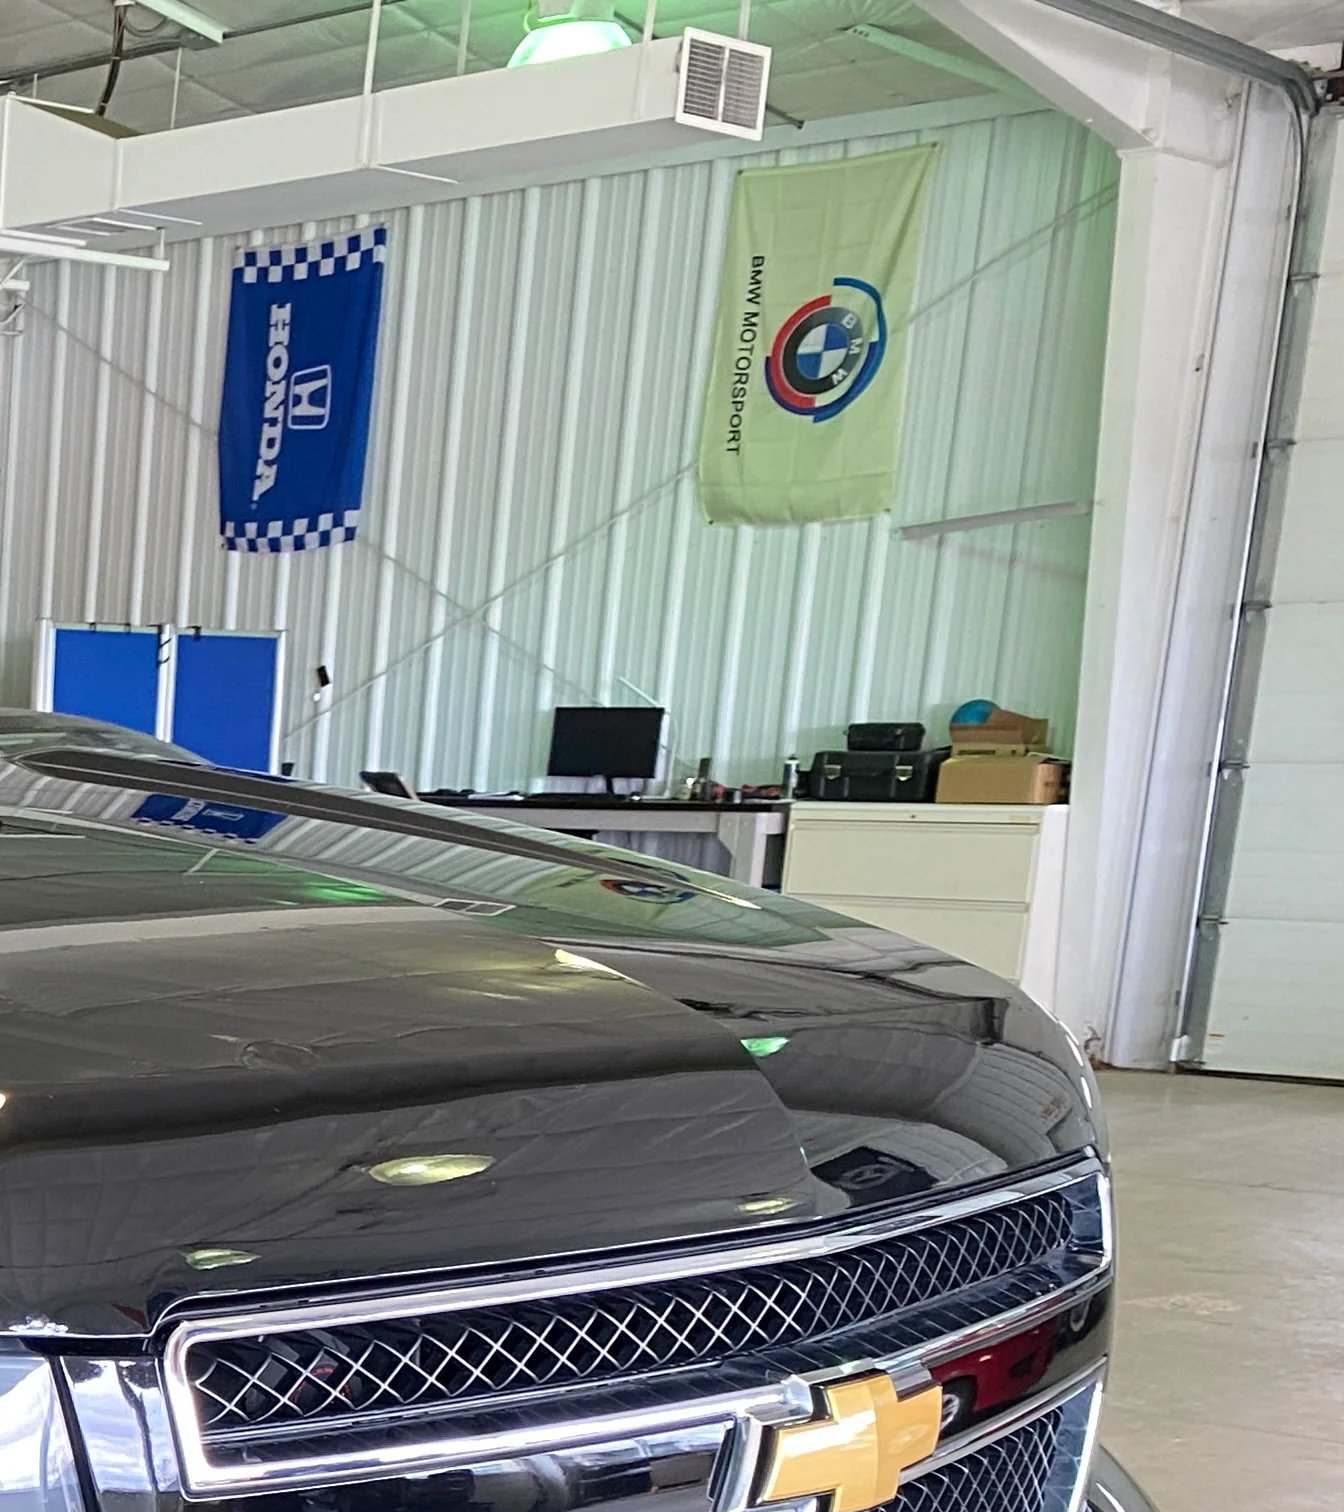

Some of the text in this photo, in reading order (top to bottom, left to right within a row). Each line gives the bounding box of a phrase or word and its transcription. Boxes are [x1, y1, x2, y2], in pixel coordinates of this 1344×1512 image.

[252, 302, 292, 501] HONDA
[725, 255, 765, 457] BMW MOTORSPORT
